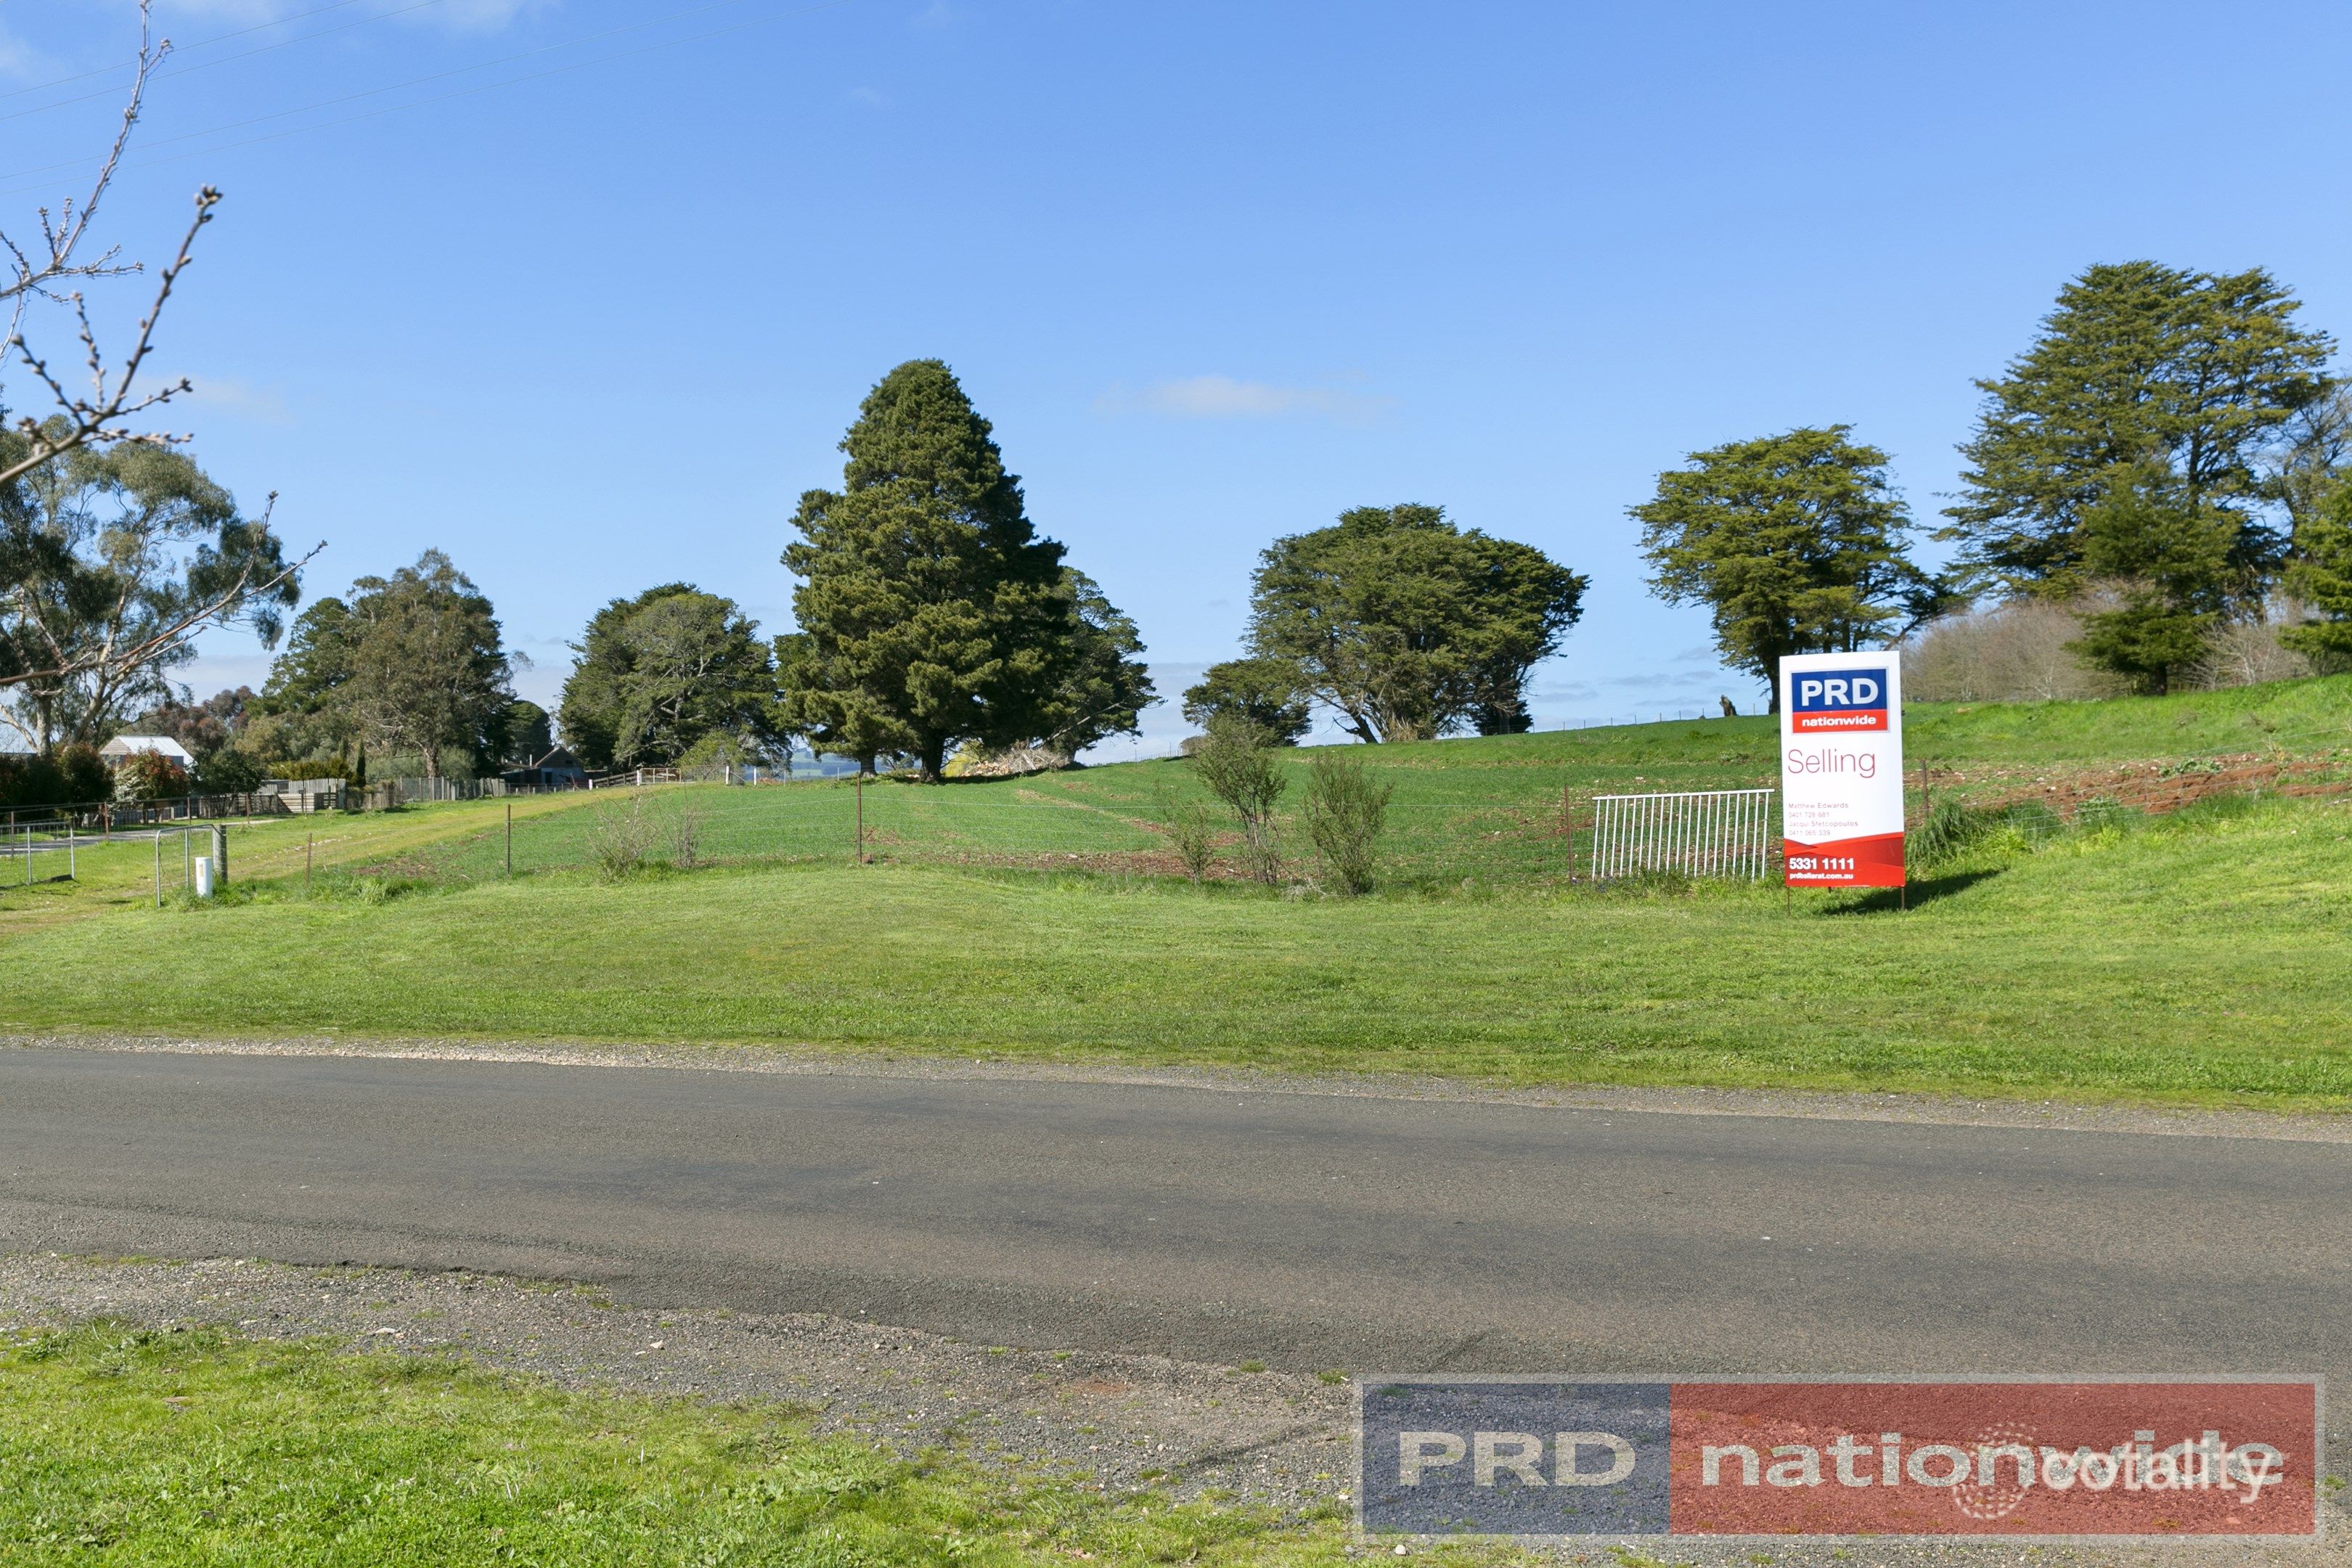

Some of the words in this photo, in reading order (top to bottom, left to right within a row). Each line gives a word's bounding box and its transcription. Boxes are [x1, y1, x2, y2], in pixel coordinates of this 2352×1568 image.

[1801, 678, 1879, 706] PRD
[1802, 715, 1877, 727] nationwide
[1788, 748, 1875, 778] Selling
[1789, 857, 1817, 870] 5331
[1822, 857, 1854, 870] 1111
